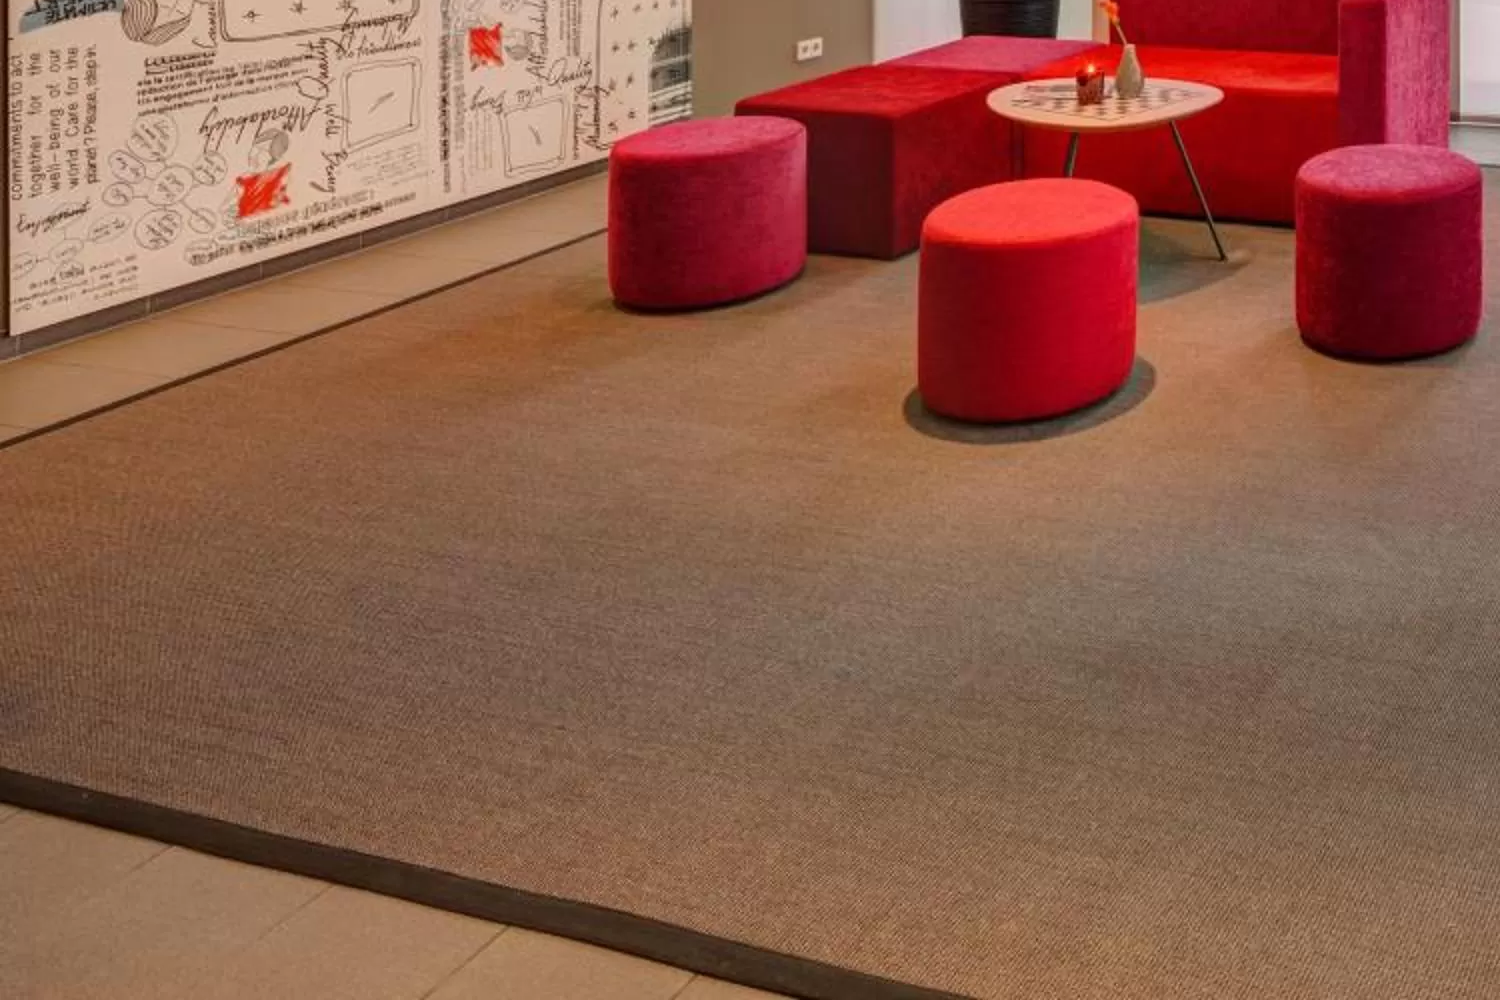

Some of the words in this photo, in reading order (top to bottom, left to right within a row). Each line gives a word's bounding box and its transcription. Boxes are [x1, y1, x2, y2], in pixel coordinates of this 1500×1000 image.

[11, 55, 23, 77] act
[30, 53, 42, 76] the
[49, 49, 60, 73] our
[65, 47, 78, 70] the
[46, 84, 59, 99] of
[67, 76, 78, 95] for
[27, 95, 42, 115] for
[65, 103, 80, 137] Care
[200, 100, 322, 154] Affordability
[11, 100, 23, 200] commitments
[28, 135, 45, 198] together
